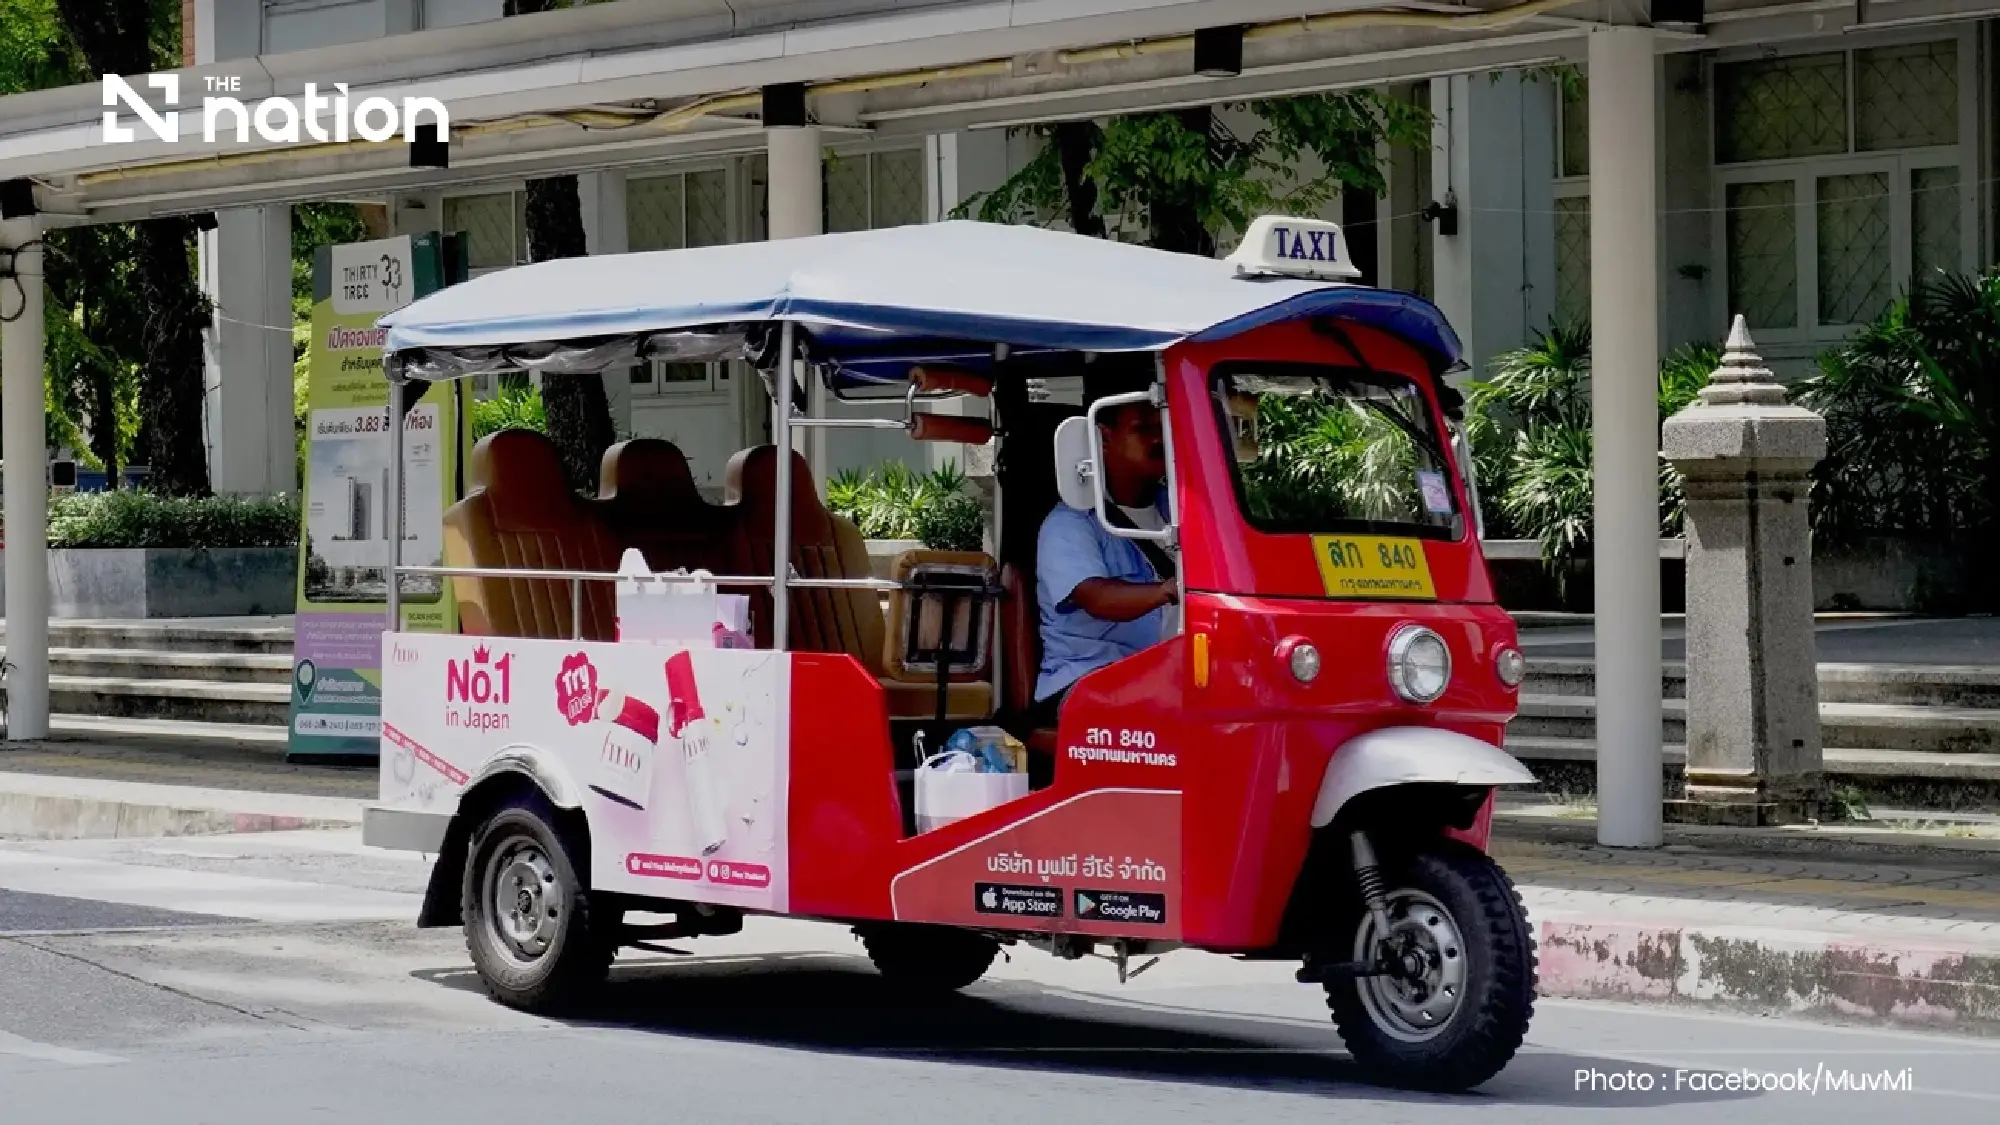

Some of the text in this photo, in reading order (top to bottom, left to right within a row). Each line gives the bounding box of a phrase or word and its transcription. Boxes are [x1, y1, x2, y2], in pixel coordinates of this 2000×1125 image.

[1273, 227, 1338, 263] TAXI
[342, 265, 378, 283] THIRTY
[354, 415, 379, 432] 3.83
[1327, 539, 1416, 569] สก 840
[446, 652, 510, 704] No.1
[562, 664, 590, 697] Try
[445, 705, 510, 734] in Japan
[1085, 727, 1156, 749] สก 840
[1067, 745, 1178, 767] กรุงเทพมหานคร
[986, 851, 1166, 883] บริษัท มูฟมี ฮีโร่ จำกัด
[1002, 887, 1034, 897] Download
[1002, 898, 1057, 913] App Store
[1099, 903, 1161, 921] Google Play
